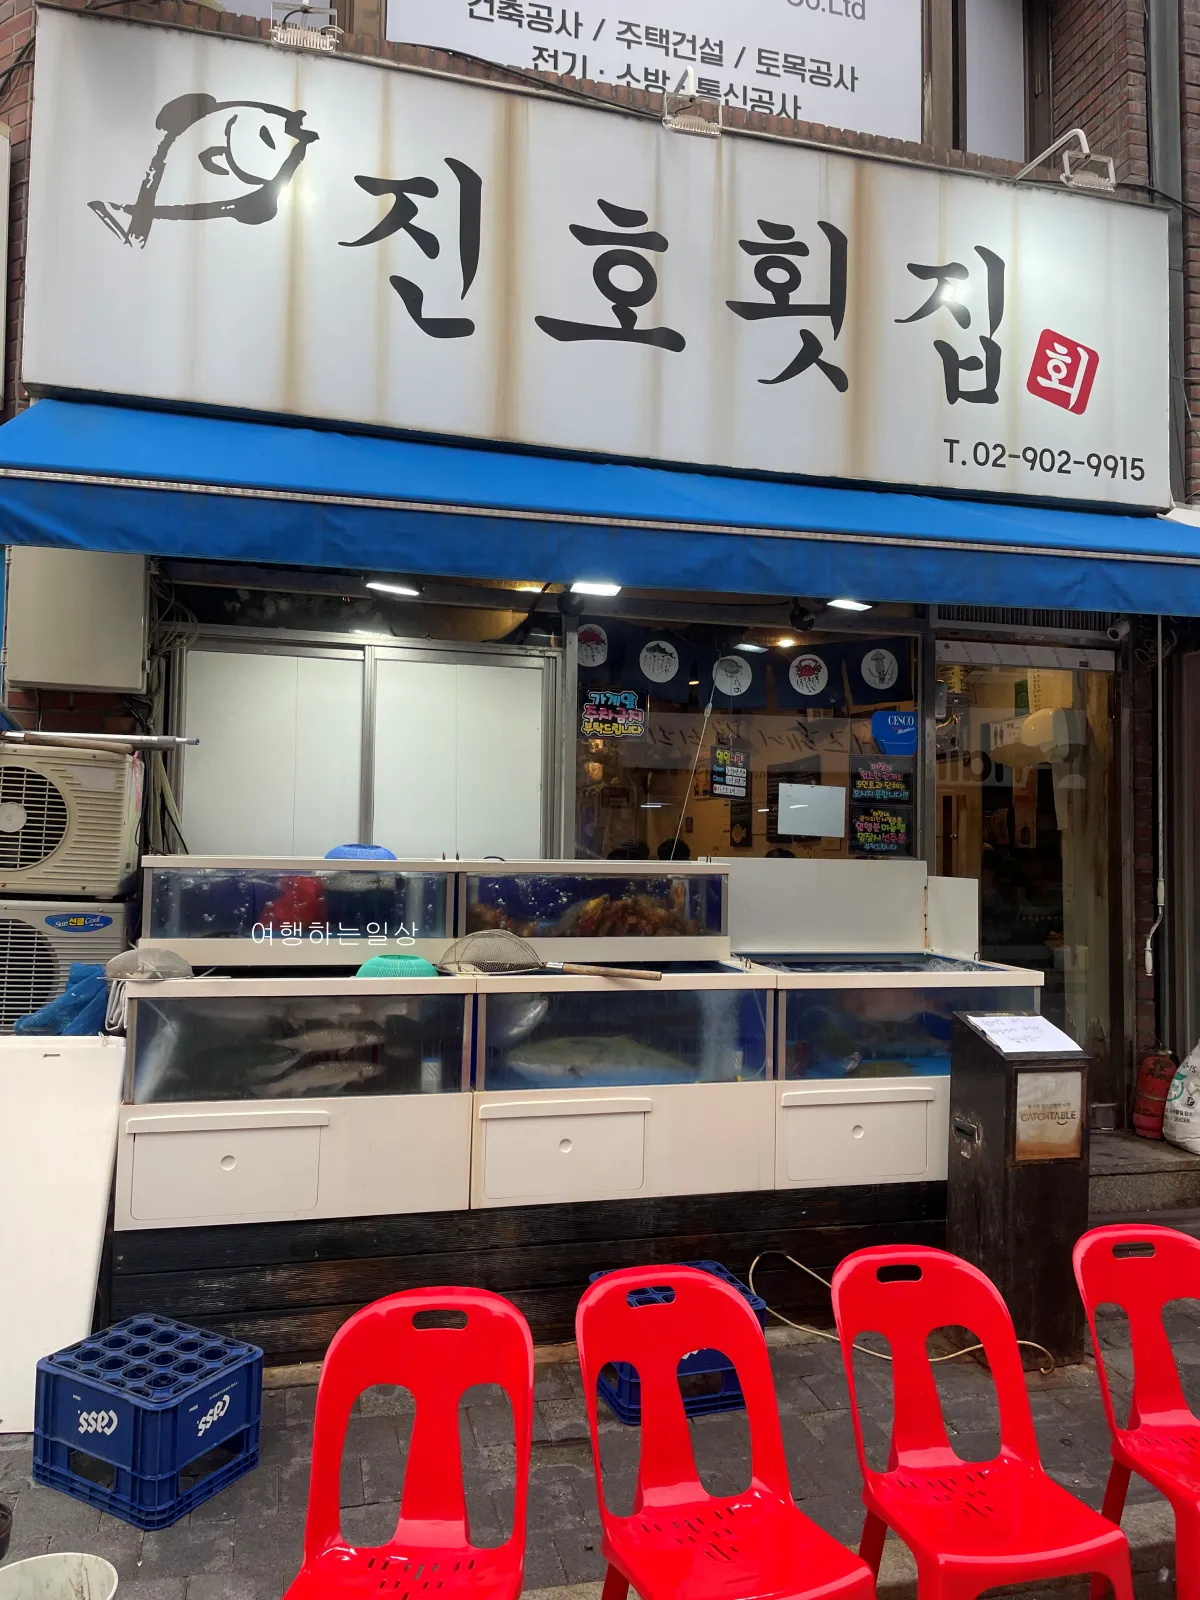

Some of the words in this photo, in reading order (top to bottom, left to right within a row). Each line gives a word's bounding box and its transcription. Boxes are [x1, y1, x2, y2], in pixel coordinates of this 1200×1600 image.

[468, 0, 583, 39] 건축공사
[616, 20, 724, 67] 주택건설
[756, 48, 859, 92] 토목공사
[532, 46, 587, 79] 전기
[696, 77, 801, 121] 통신공사
[338, 157, 1006, 405] 진호횟집
[1036, 342, 1089, 410] 회
[590, 692, 637, 709] 가게앞
[584, 705, 643, 724] 주차금지
[888, 715, 914, 726] CESCO
[583, 721, 643, 735] 부탁드립니다
[716, 749, 744, 766] 영업시간
[1021, 1110, 1076, 1122] CATCHTABLE
[78, 1409, 118, 1436] Cass
[197, 1394, 230, 1437] Cass
